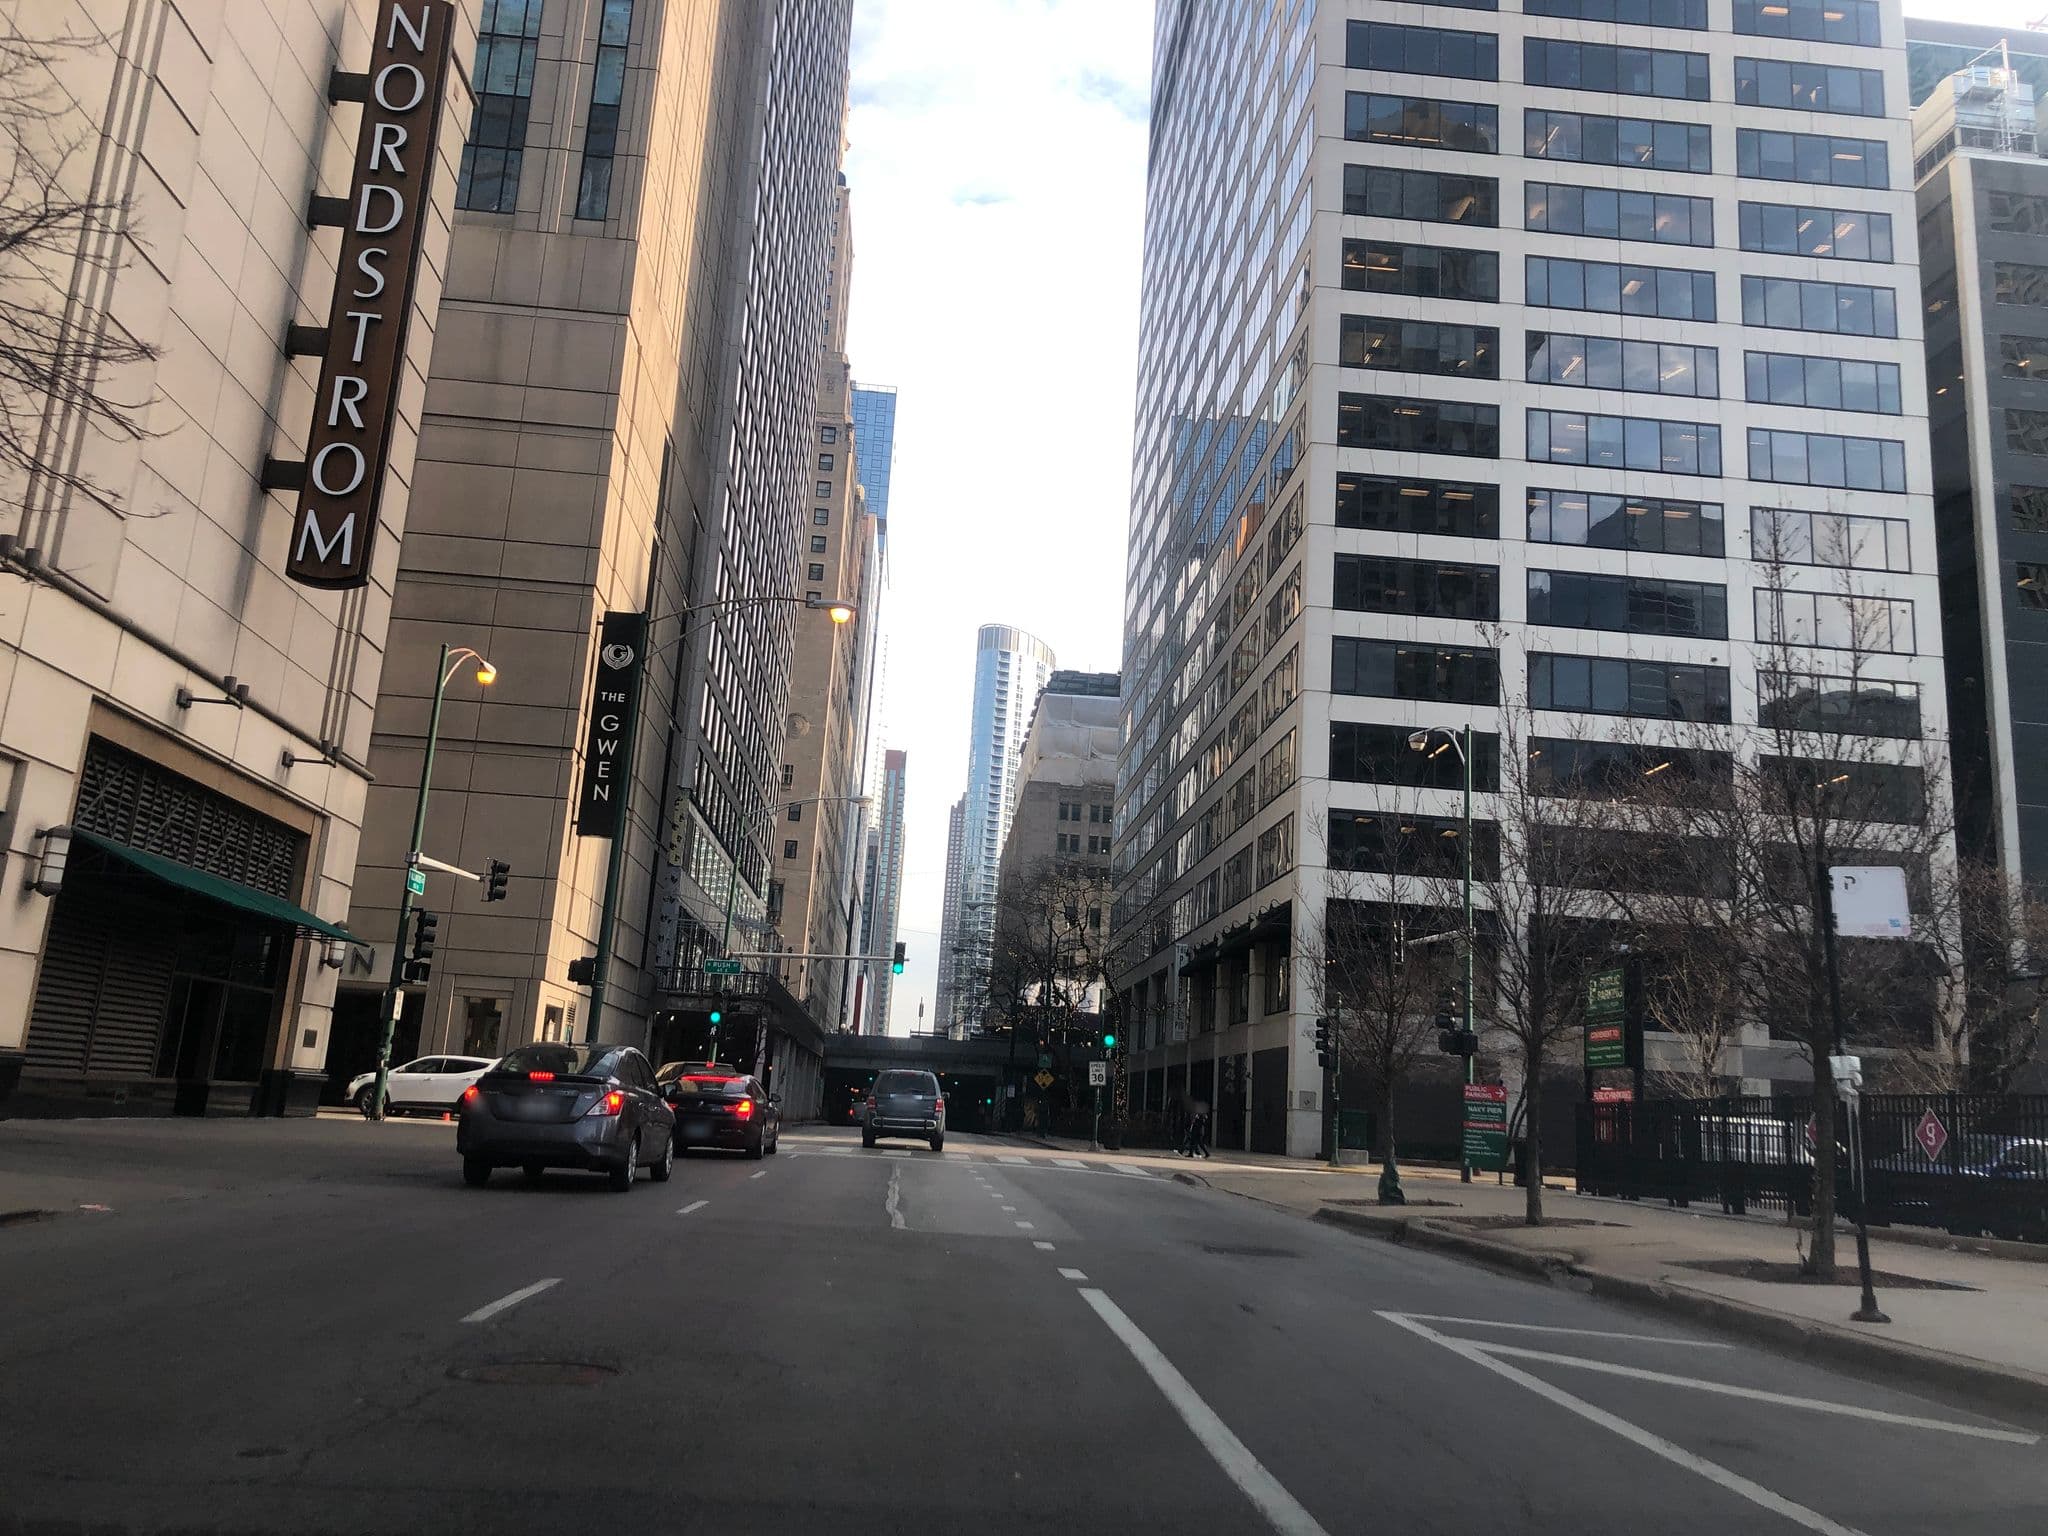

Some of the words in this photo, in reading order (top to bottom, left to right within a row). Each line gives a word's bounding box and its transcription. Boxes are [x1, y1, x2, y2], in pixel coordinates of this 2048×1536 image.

[295, 2, 431, 567] NORDSTROM
[600, 691, 626, 704] THE
[592, 713, 620, 802] GWEN
[1091, 1073, 1104, 1083] 30
[1465, 1091, 1493, 1099] PARKING
